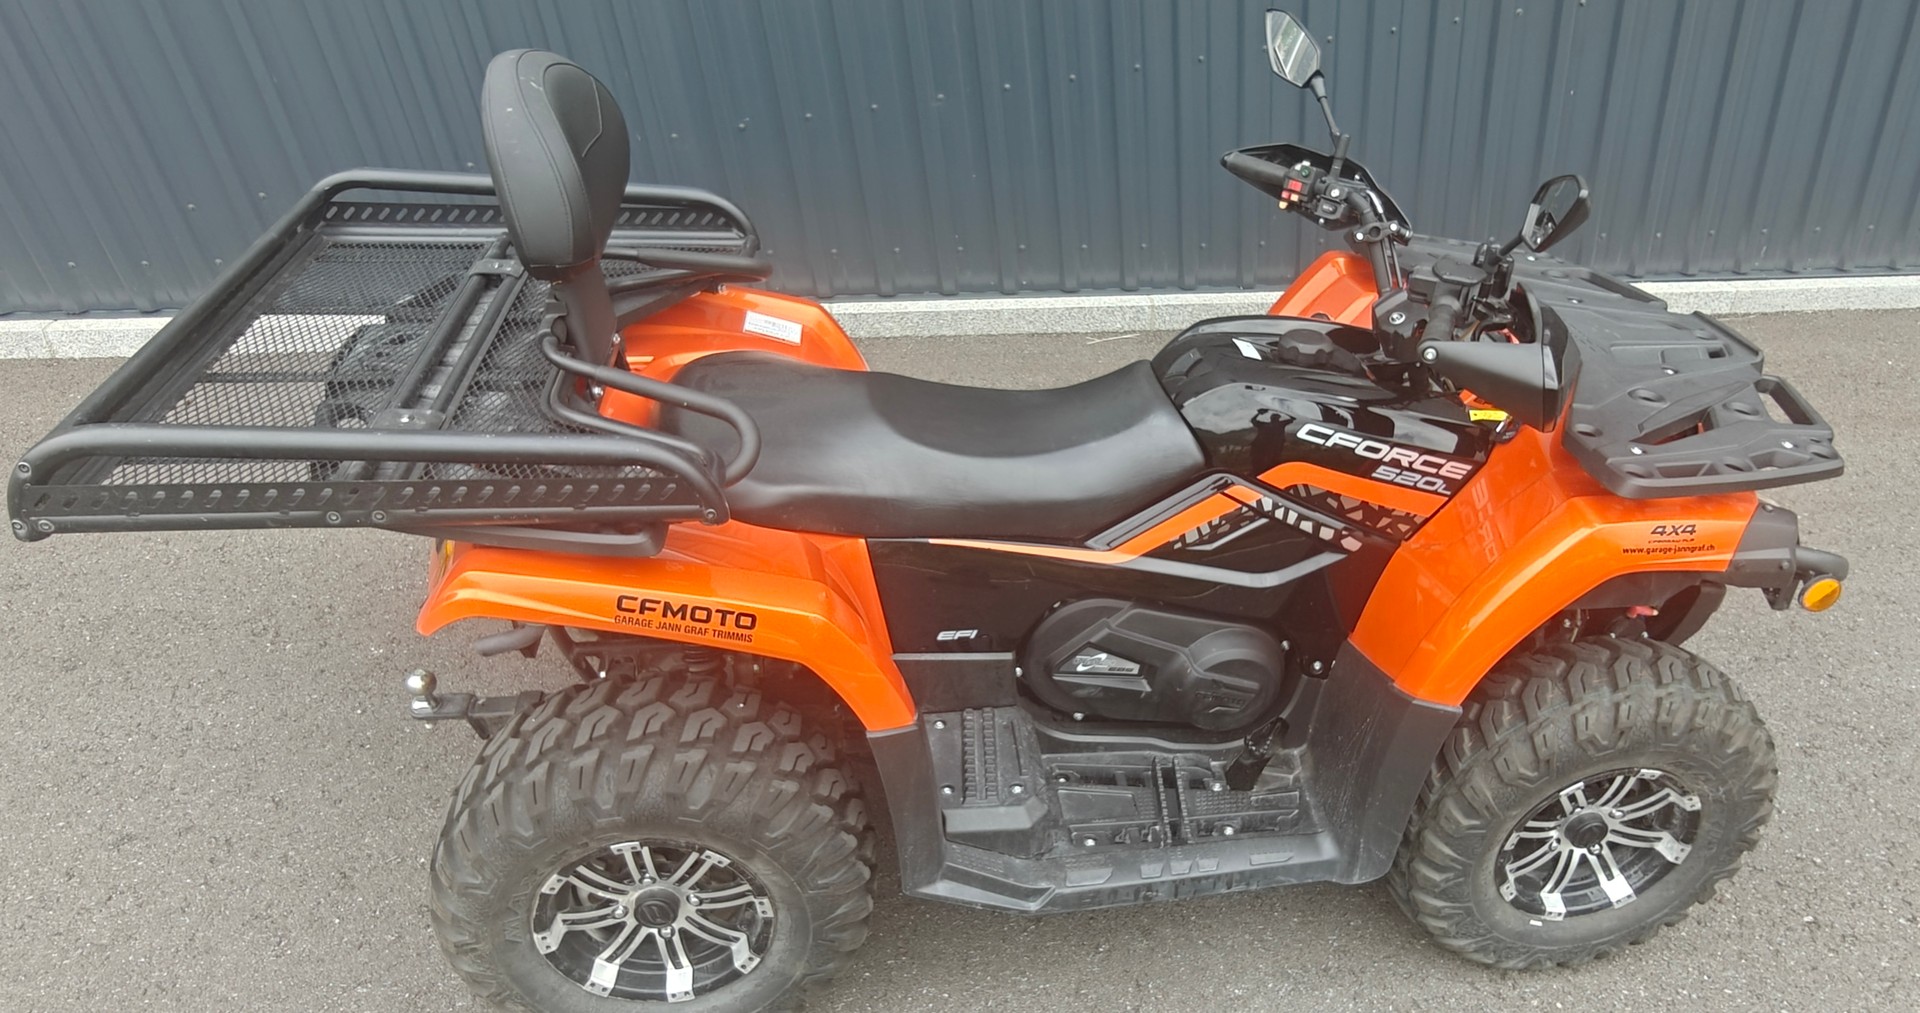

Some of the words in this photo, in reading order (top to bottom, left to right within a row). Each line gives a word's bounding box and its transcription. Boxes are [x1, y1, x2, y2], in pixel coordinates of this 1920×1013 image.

[1296, 423, 1473, 480] CFORCE
[1371, 465, 1451, 495] 520L
[616, 594, 758, 631] CFMOTO
[614, 614, 653, 629] GARAGE
[655, 621, 682, 633] JANN
[684, 624, 710, 636] GRAF
[712, 628, 753, 643] TRIMMIS
[936, 629, 979, 641] EFI
